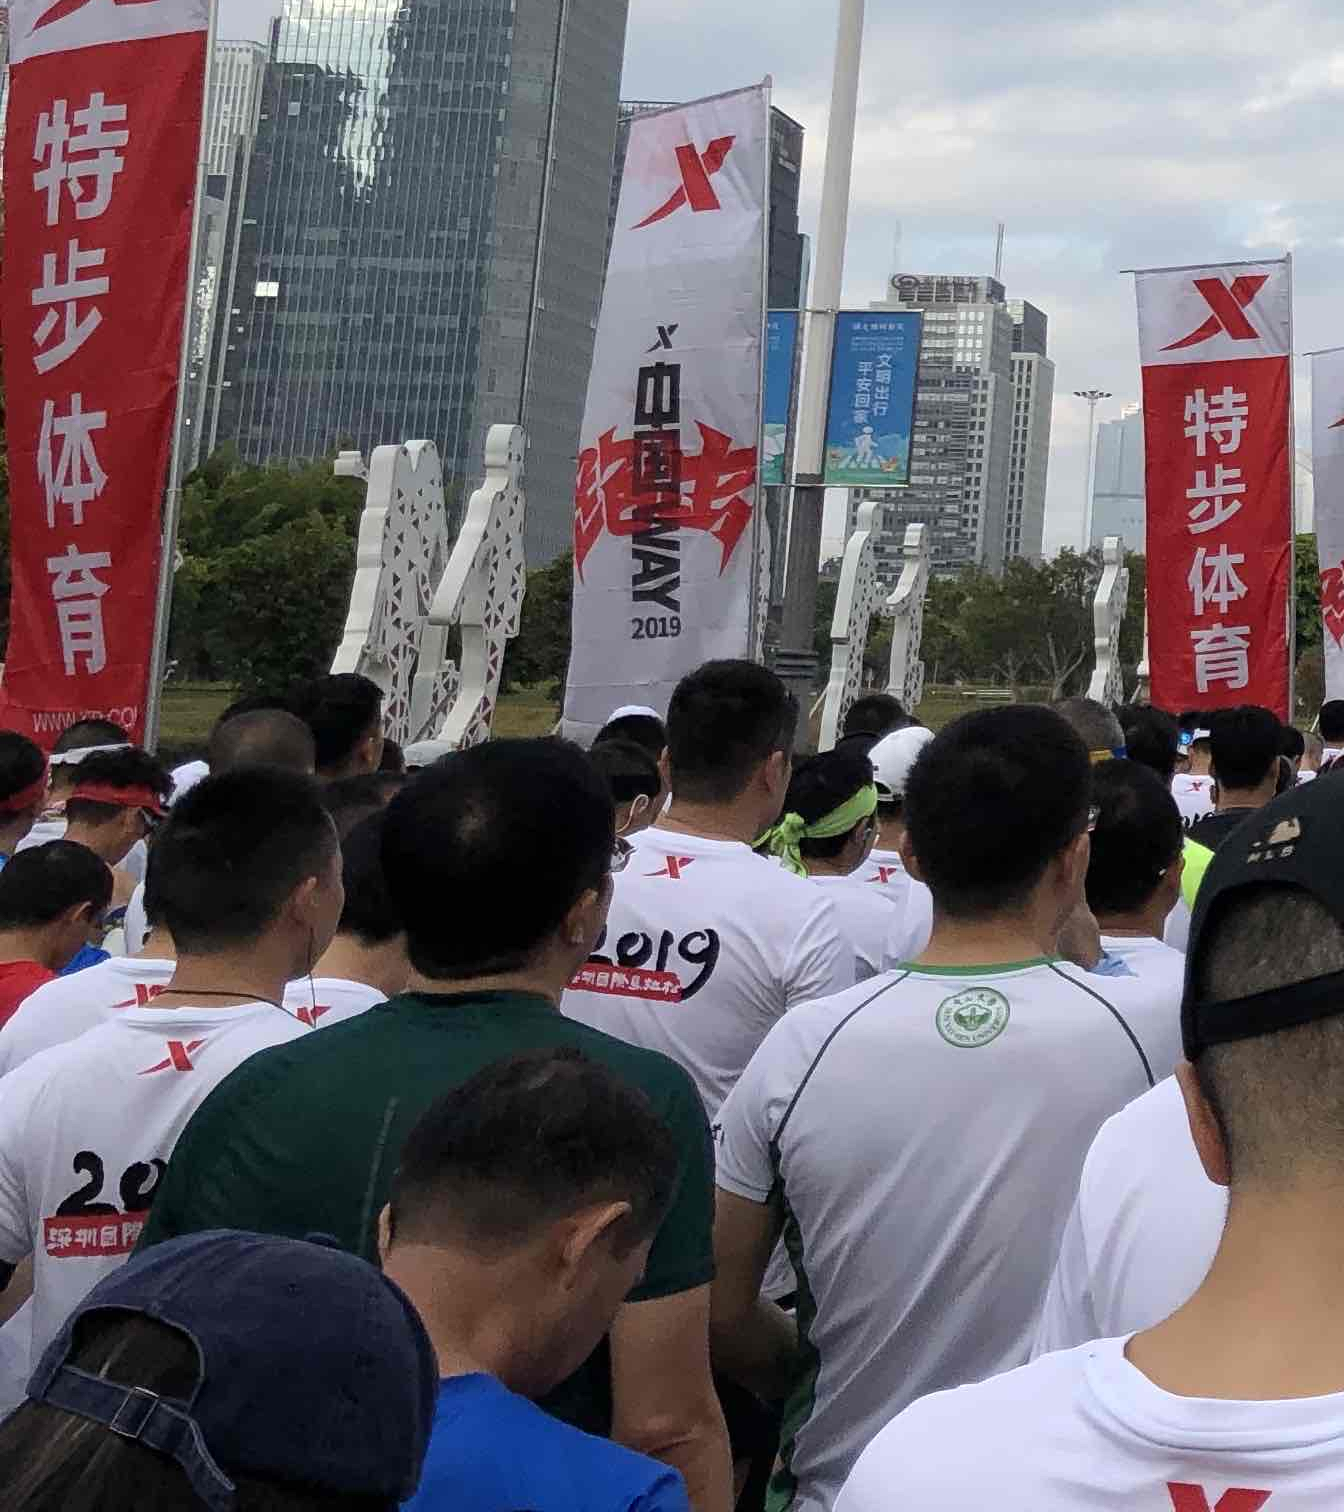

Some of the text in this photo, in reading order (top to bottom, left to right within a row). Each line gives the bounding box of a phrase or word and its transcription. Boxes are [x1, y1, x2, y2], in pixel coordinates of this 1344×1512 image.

[32, 92, 130, 676] 特步体育
[1183, 385, 1251, 694] 特步体育
[631, 616, 682, 640] 2019
[1247, 845, 1295, 865] MLB
